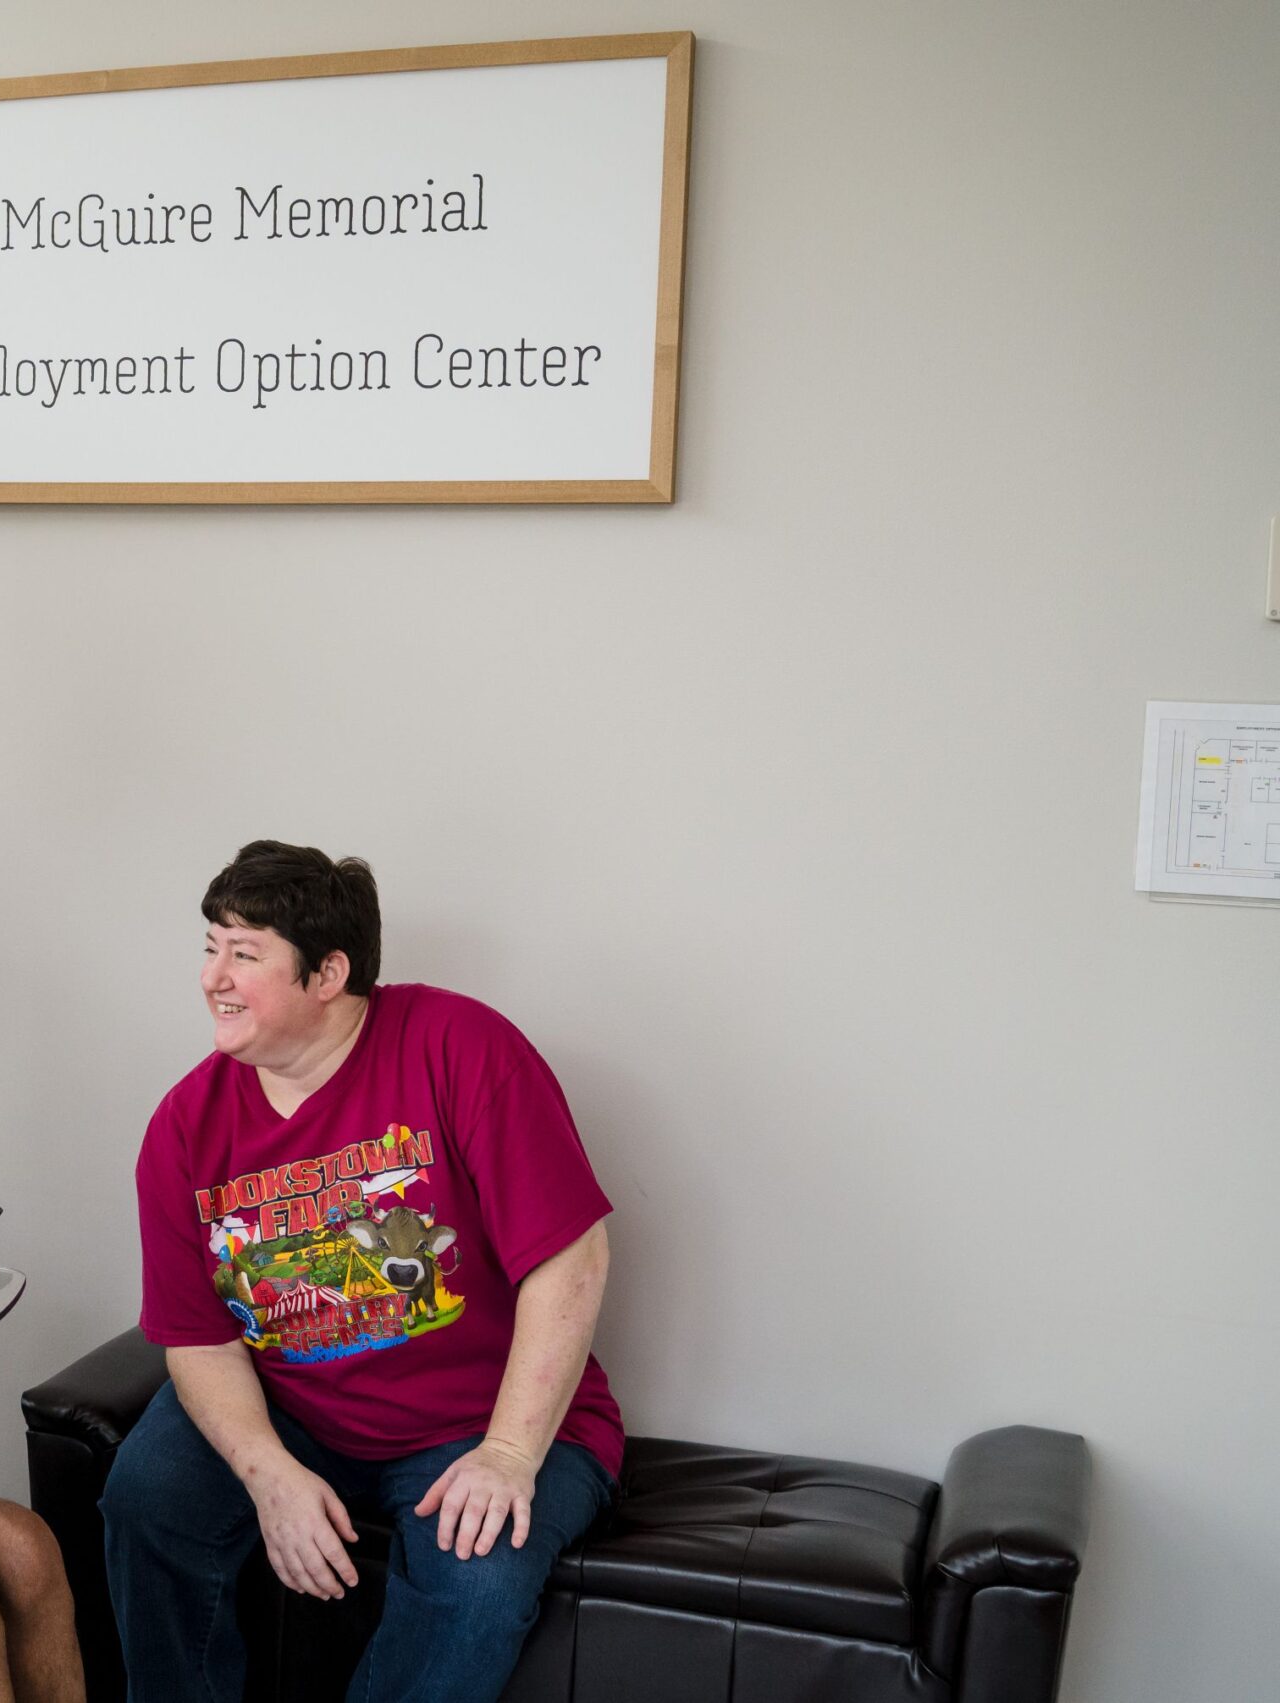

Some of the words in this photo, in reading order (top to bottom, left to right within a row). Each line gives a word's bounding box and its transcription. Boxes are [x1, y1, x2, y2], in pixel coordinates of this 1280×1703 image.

[1, 191, 213, 253] McGuire
[233, 173, 489, 241] Memorial
[216, 338, 391, 410] Option
[413, 333, 602, 390] Center
[260, 1180, 363, 1242] FAIR
[280, 1318, 405, 1354] SCENES
